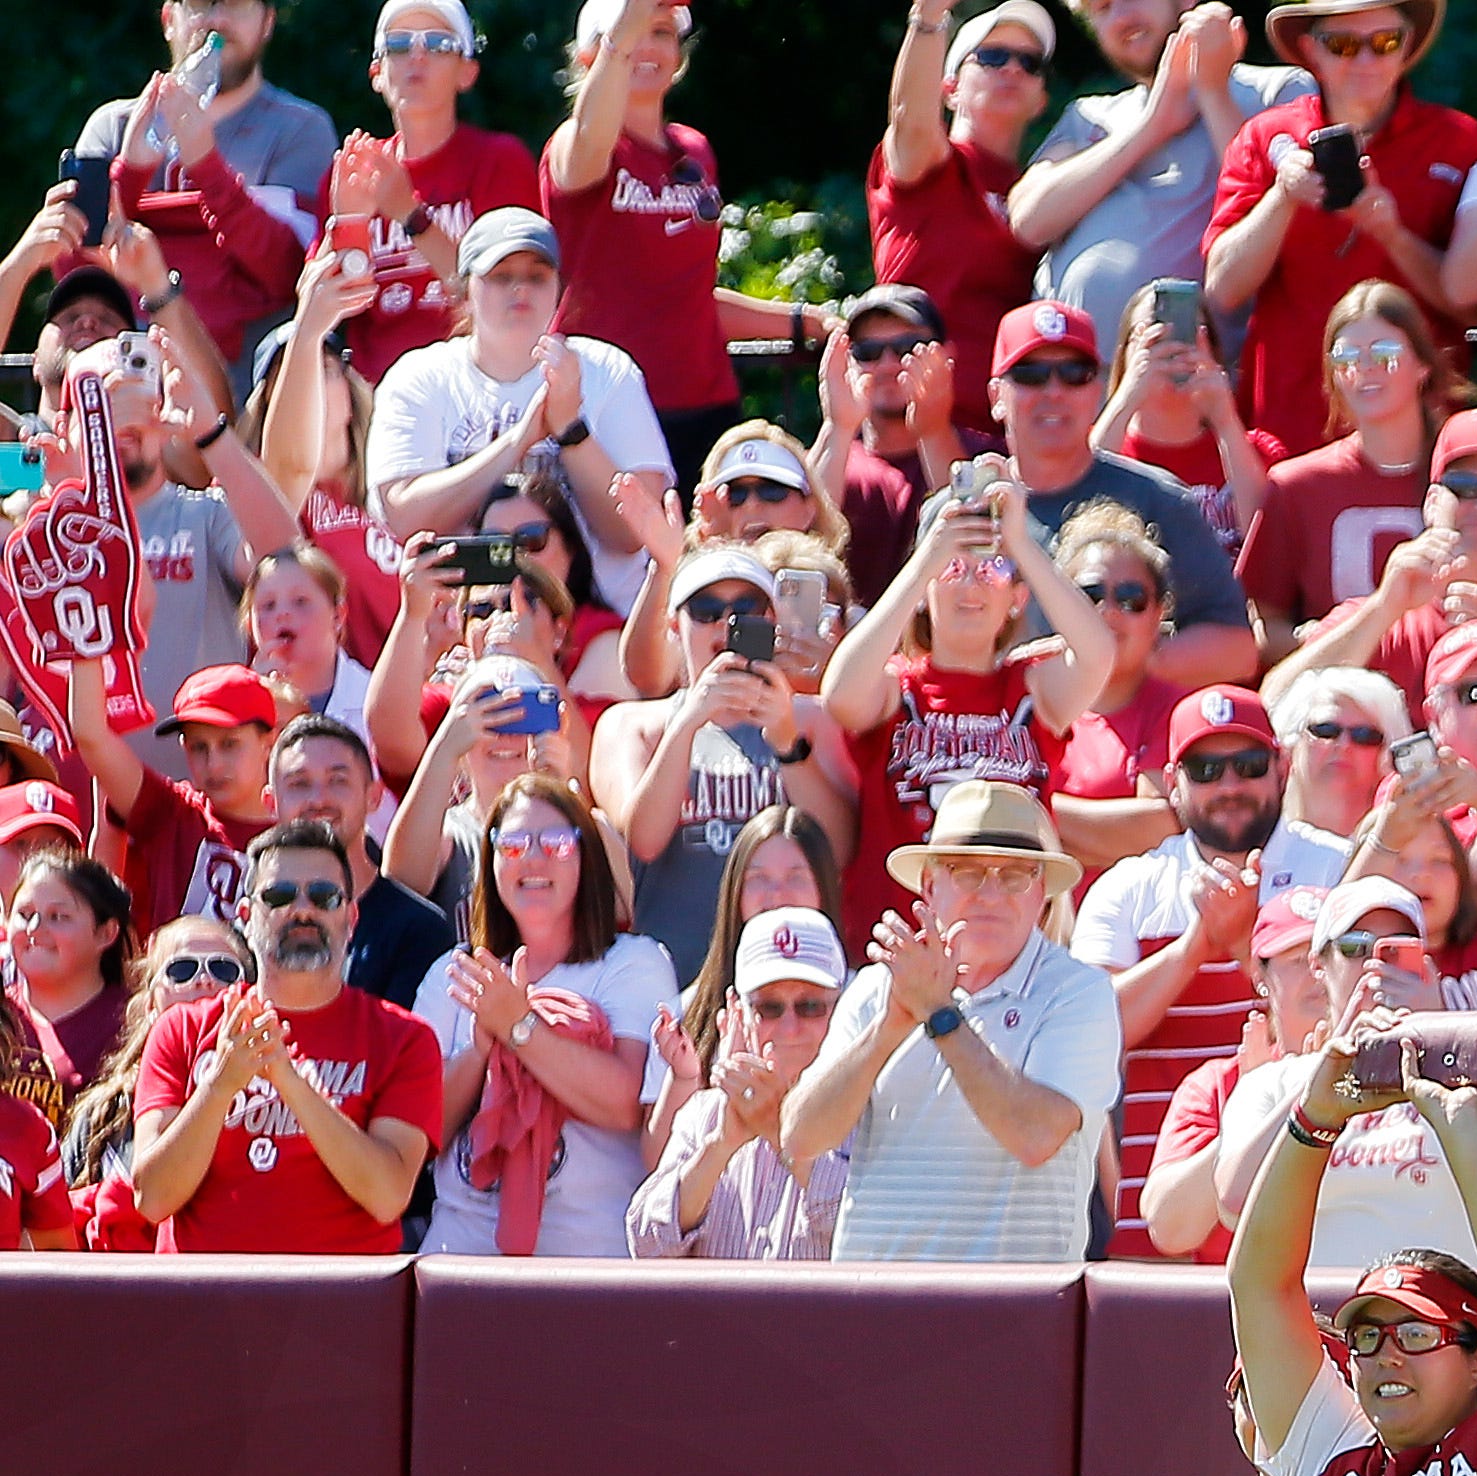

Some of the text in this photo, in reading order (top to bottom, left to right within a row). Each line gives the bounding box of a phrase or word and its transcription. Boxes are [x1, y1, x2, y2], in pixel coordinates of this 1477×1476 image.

[54, 587, 113, 657] OU
[774, 927, 799, 959] OU
[248, 1137, 279, 1172] OU
